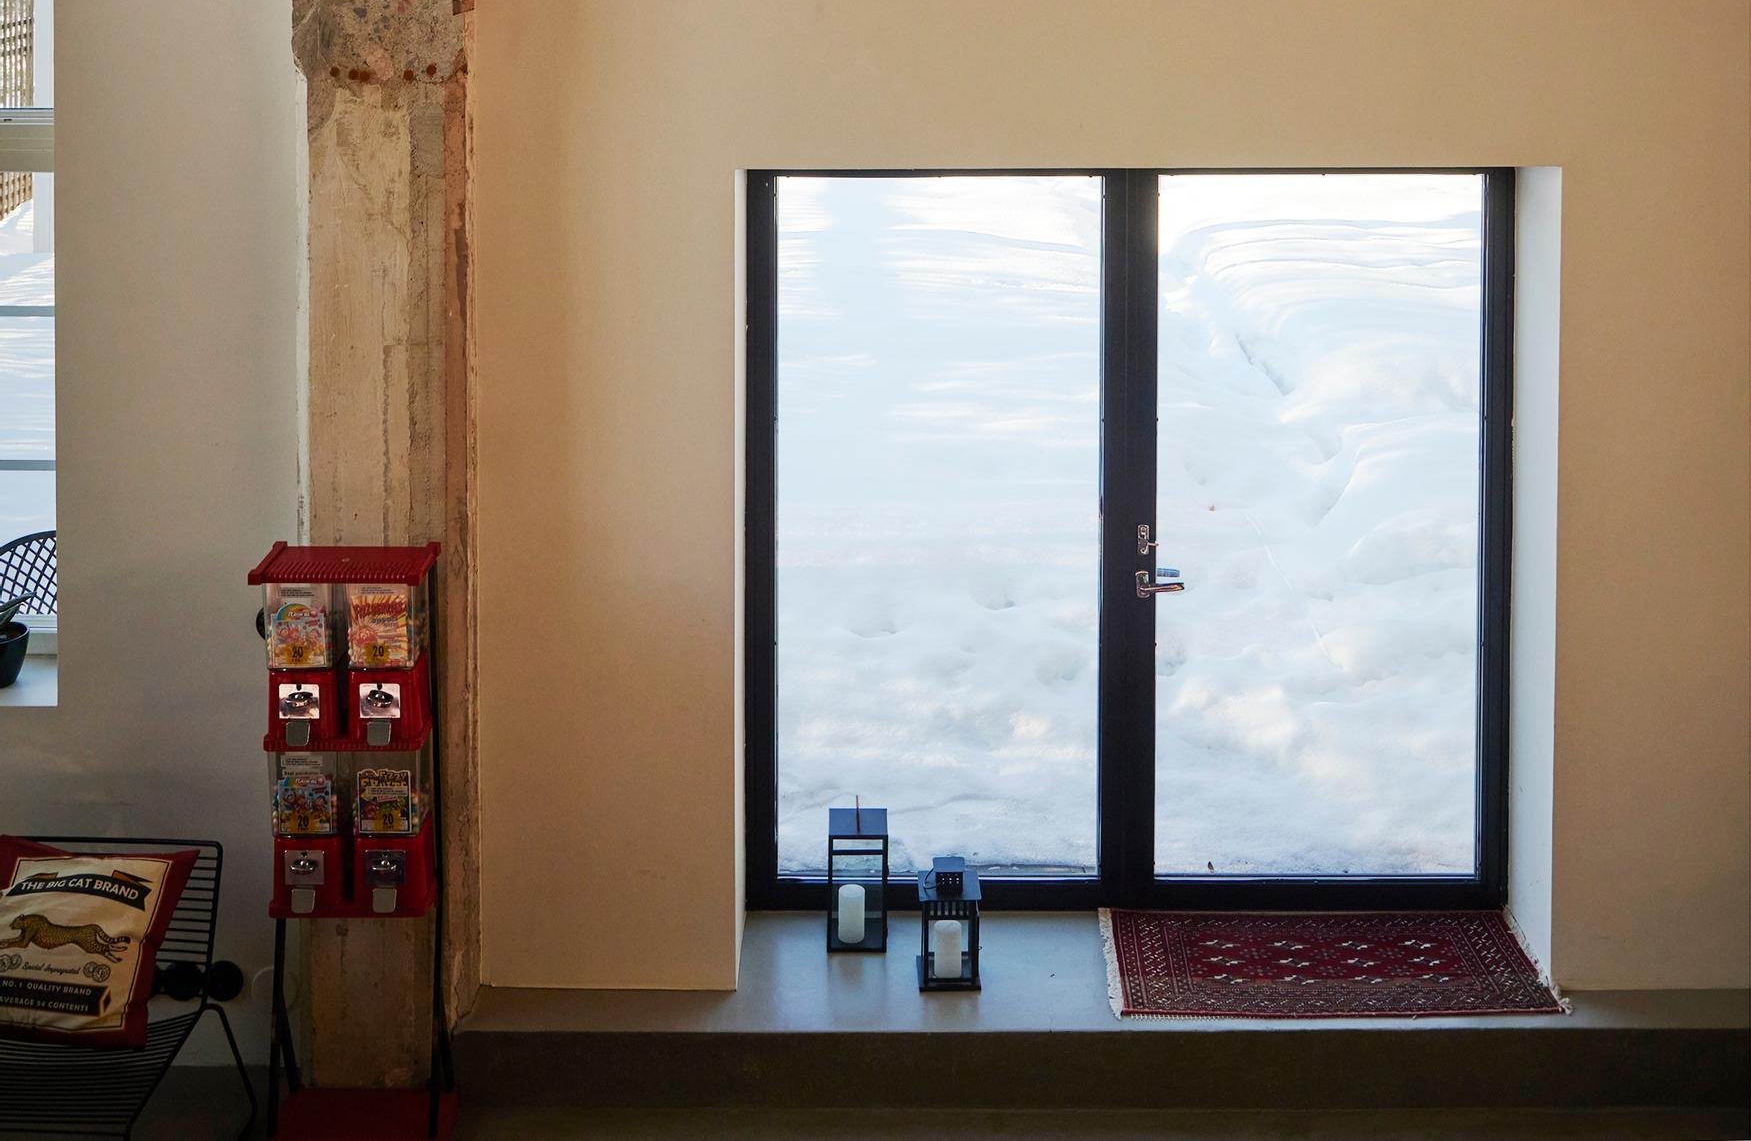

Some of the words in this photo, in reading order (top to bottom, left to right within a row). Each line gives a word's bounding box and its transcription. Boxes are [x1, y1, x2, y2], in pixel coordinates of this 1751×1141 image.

[291, 645, 304, 659] 20
[372, 645, 385, 658] 20
[297, 814, 310, 828] 20
[382, 812, 395, 826] 20
[20, 881, 46, 890] THE
[46, 879, 67, 890] BIG
[68, 878, 91, 889] CAT
[93, 879, 140, 900] BRAND
[26, 982, 61, 993] QUALITY
[62, 986, 93, 996] BRAND
